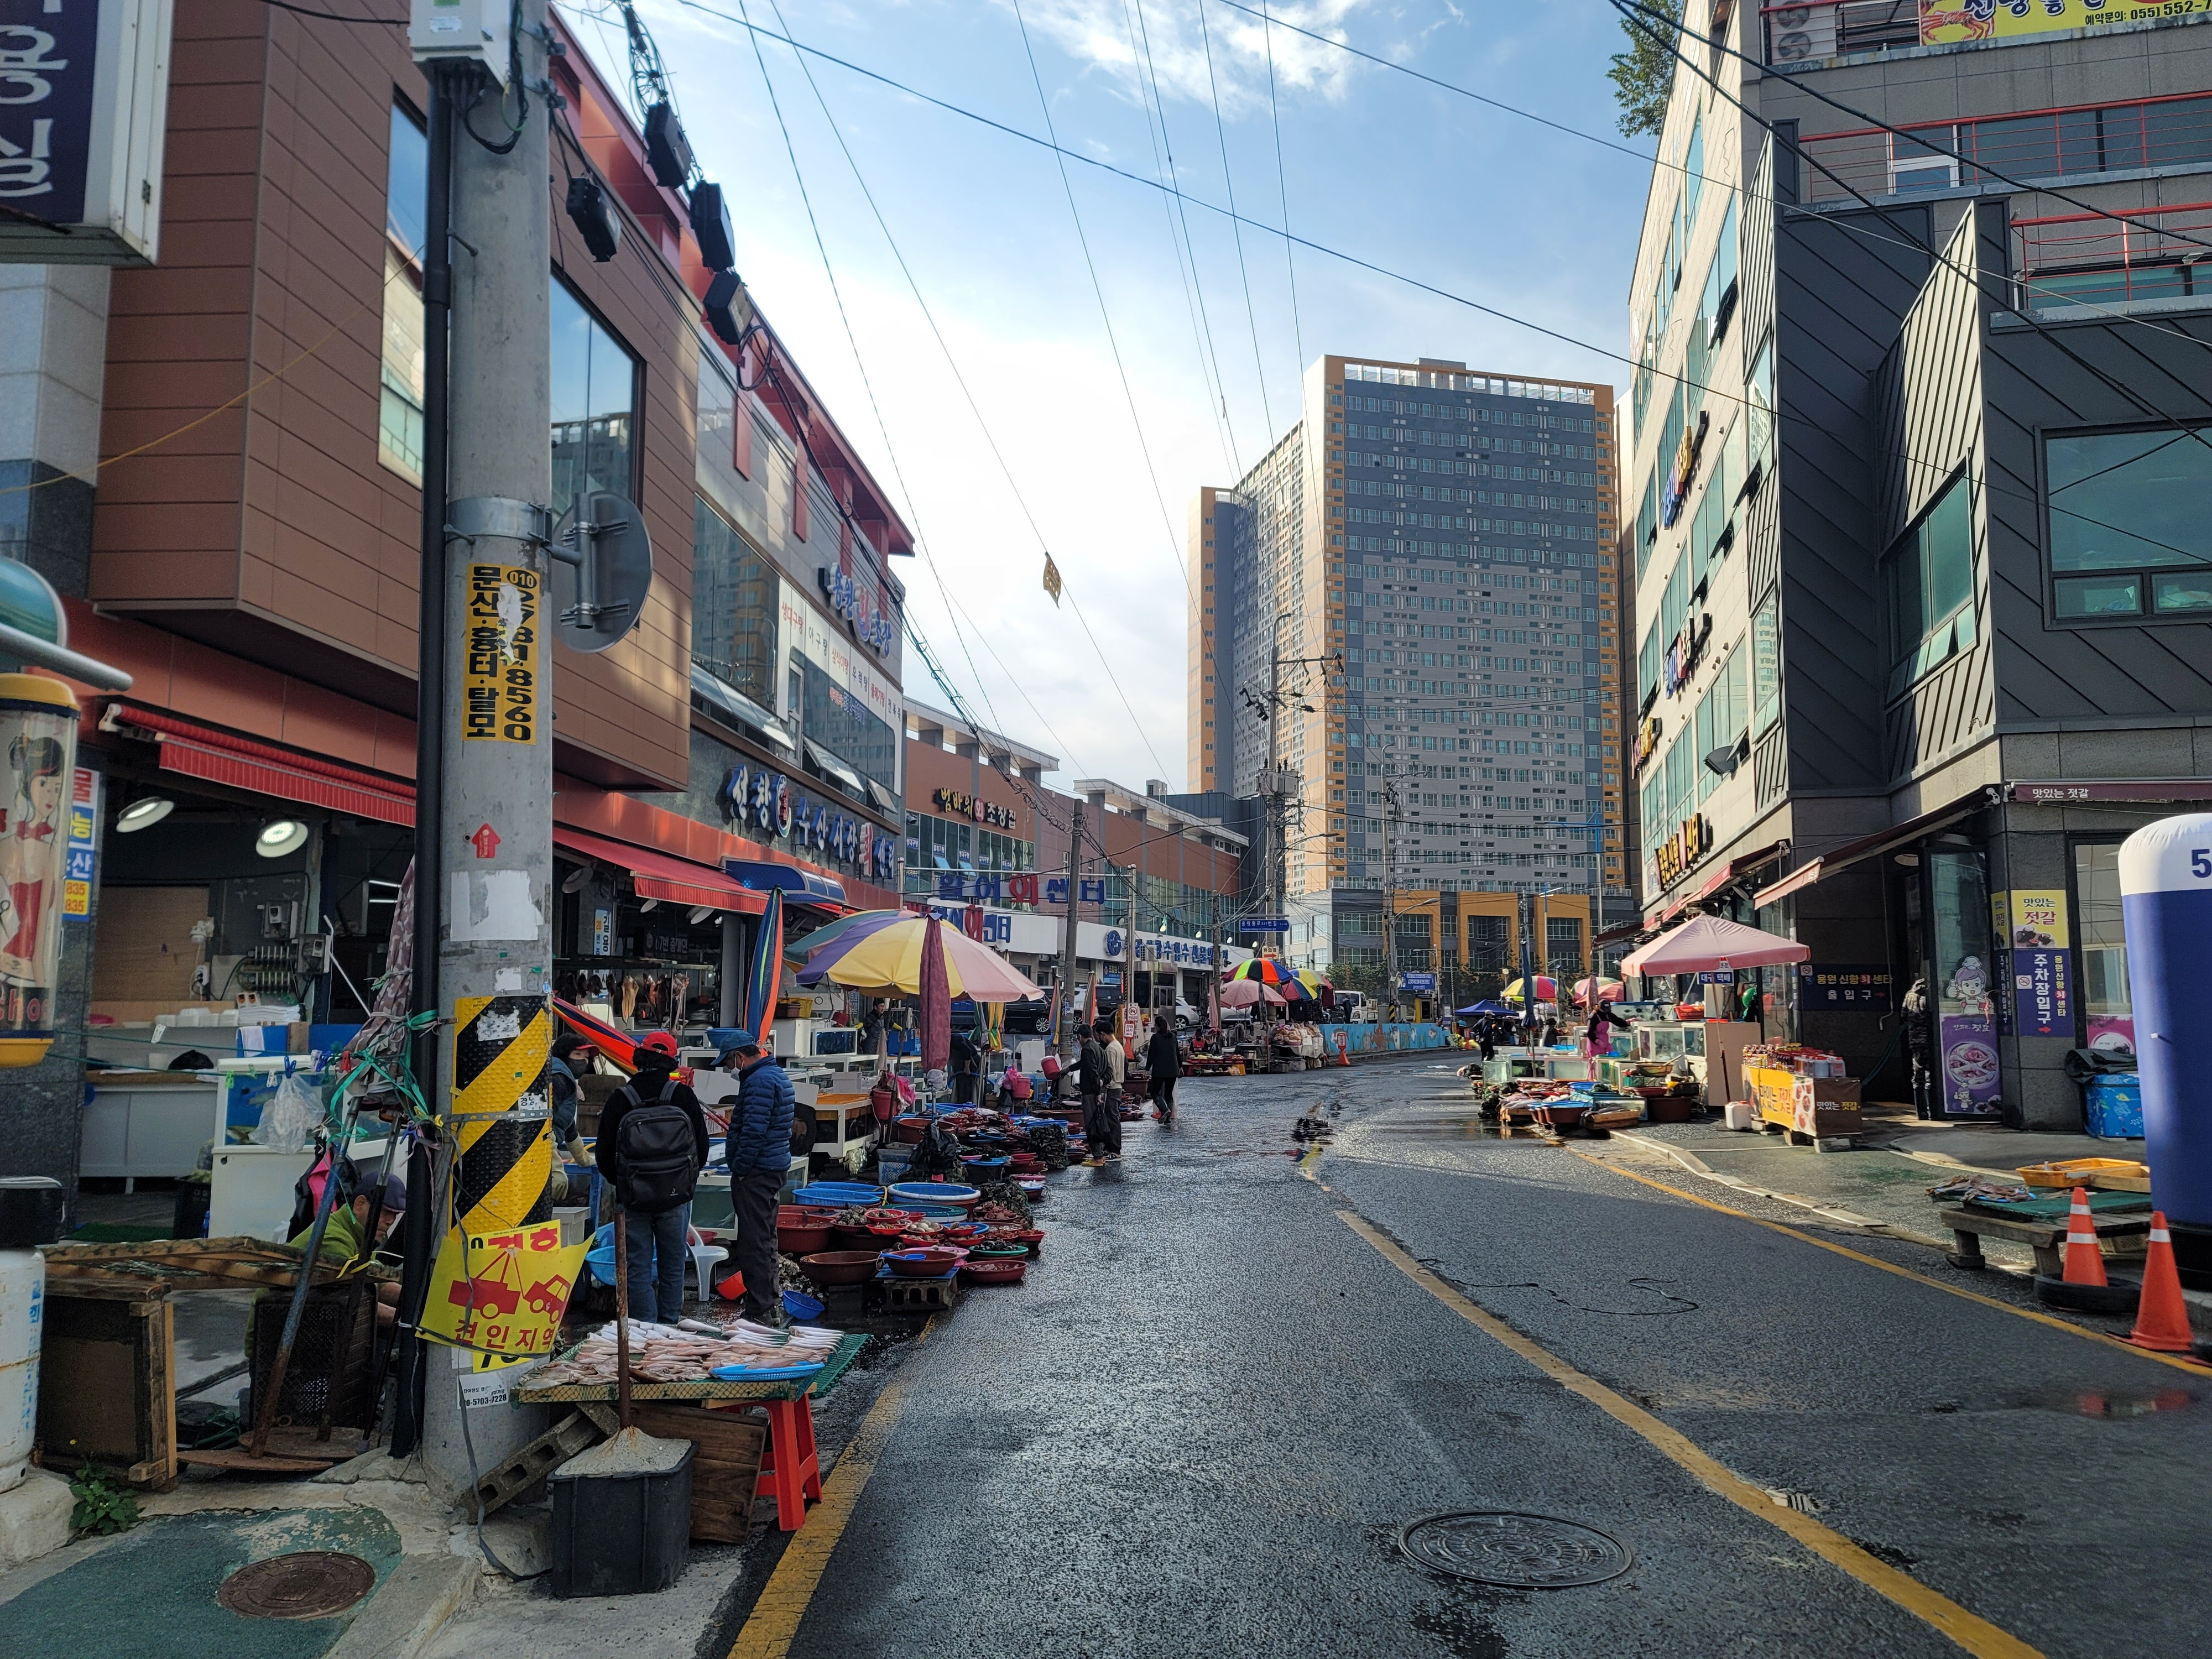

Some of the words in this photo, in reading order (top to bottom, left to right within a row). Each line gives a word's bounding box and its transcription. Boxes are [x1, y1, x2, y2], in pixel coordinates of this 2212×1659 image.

[2130, 7, 2160, 20] 055)
[0, 0, 67, 197] 용실
[509, 571, 535, 588] 010
[782, 601, 803, 635] 생대구탕
[808, 627, 828, 656] 아구탕
[832, 647, 849, 675] 삼식이탕
[852, 666, 868, 692] 우럭탕
[888, 698, 901, 722] 전복죽
[2032, 788, 2064, 799] 맛있는
[2067, 788, 2089, 799] 젓갈
[2191, 848, 2212, 878] 5
[2023, 898, 2056, 908] 맛있는
[2024, 911, 2057, 925] 젓갈
[1717, 973, 1731, 982] 택배
[1817, 974, 1837, 984] 용원
[1839, 974, 1859, 984] 신항
[2033, 954, 2052, 1024] 주차장입구
[1827, 989, 1872, 1000] 출입구
[1760, 1084, 1778, 1113] 맛있는
[1778, 1087, 1791, 1114] 젓갈
[1817, 1101, 1840, 1110] 맛있는
[1841, 1101, 1858, 1111] 젓갈
[455, 1319, 556, 1352] 견인지역
